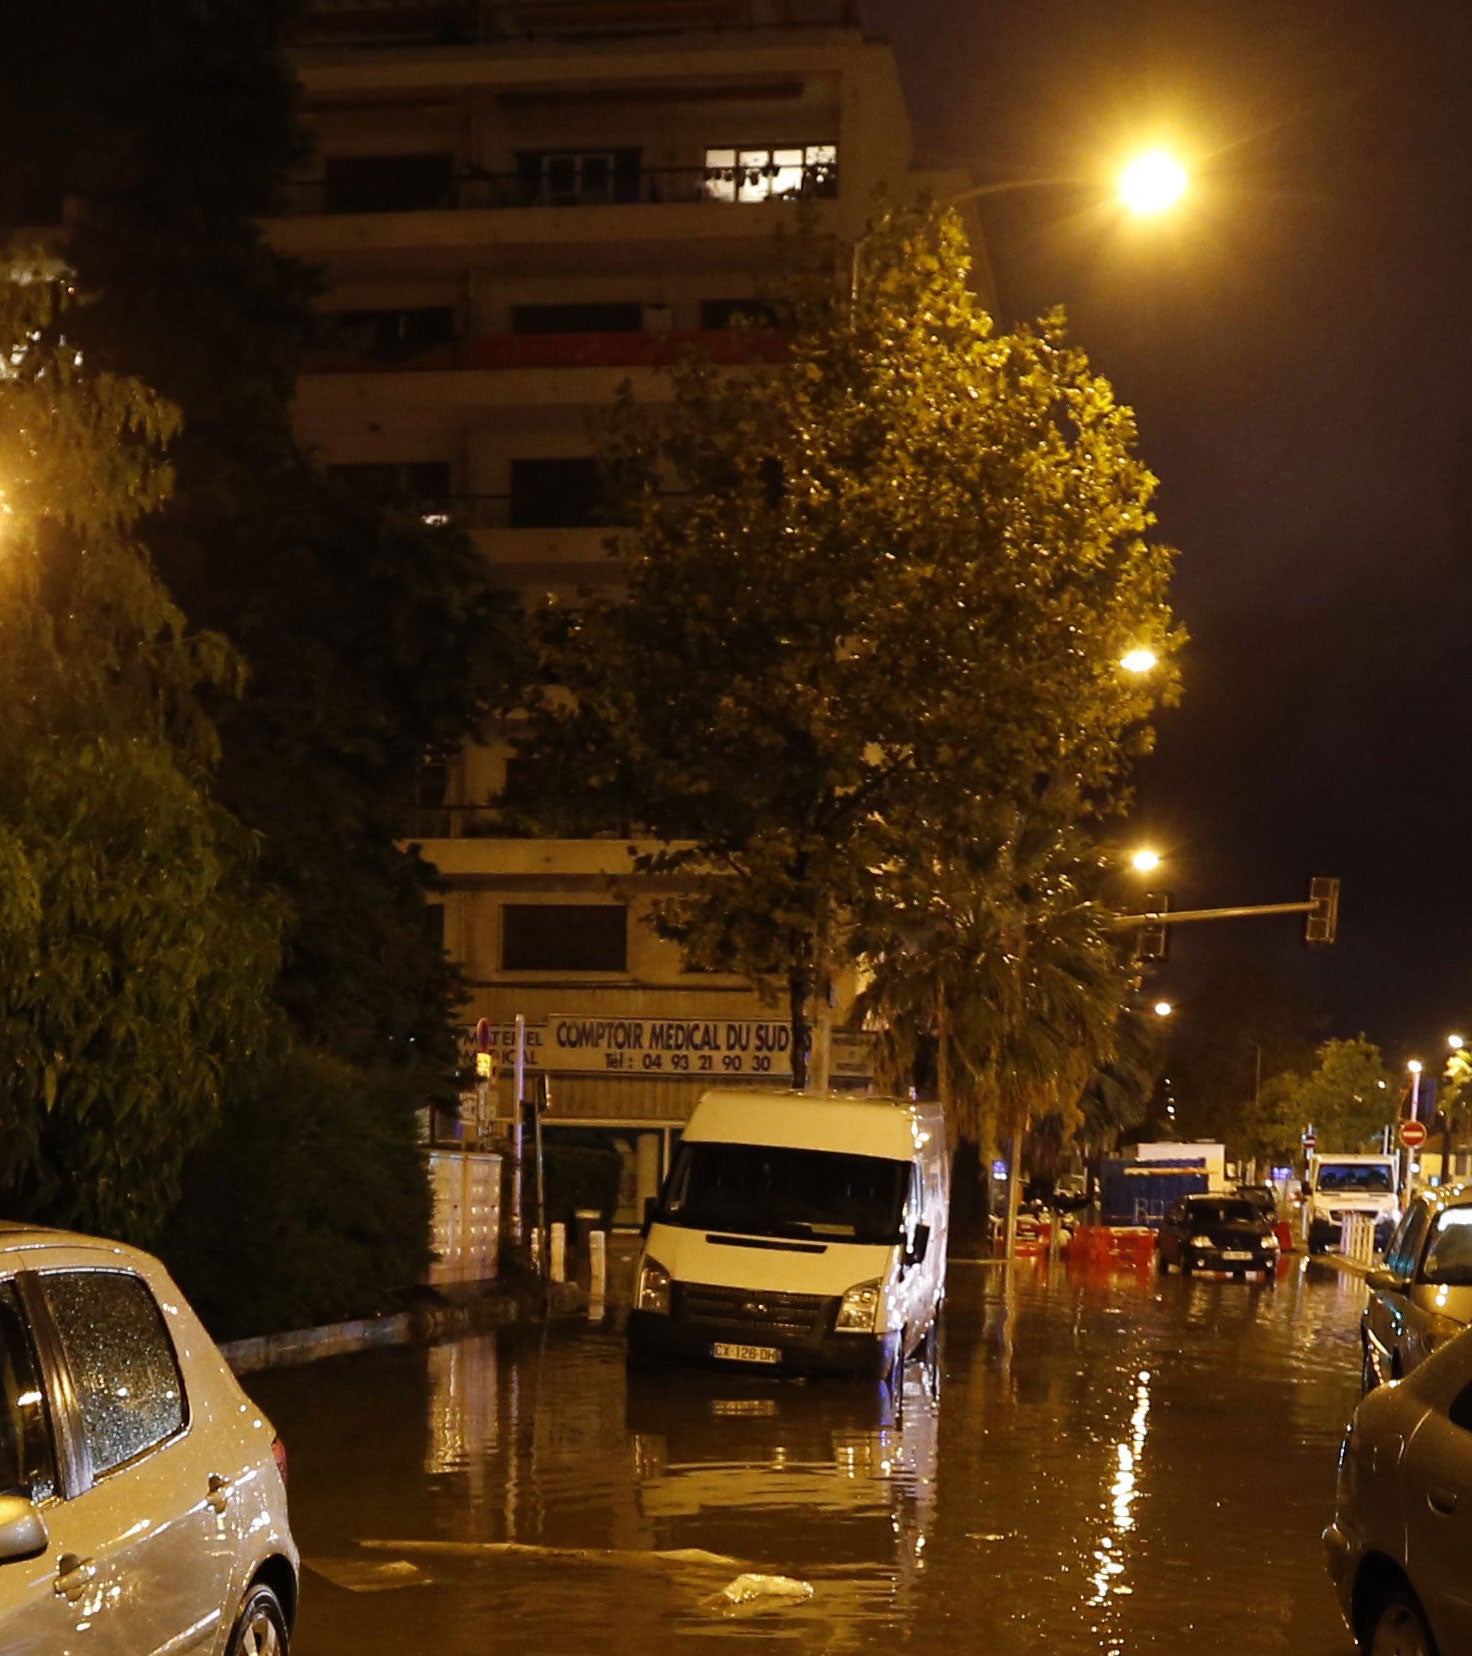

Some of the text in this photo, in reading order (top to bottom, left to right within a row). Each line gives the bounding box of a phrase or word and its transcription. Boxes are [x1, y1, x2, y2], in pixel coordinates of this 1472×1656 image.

[556, 1021, 788, 1051] COMPTOIR MEDICAL DU SUD
[642, 1053, 662, 1069] 04
[672, 1053, 688, 1070] 93
[698, 1054, 713, 1070] 21
[722, 1054, 742, 1071] 90
[752, 1055, 771, 1071] 30
